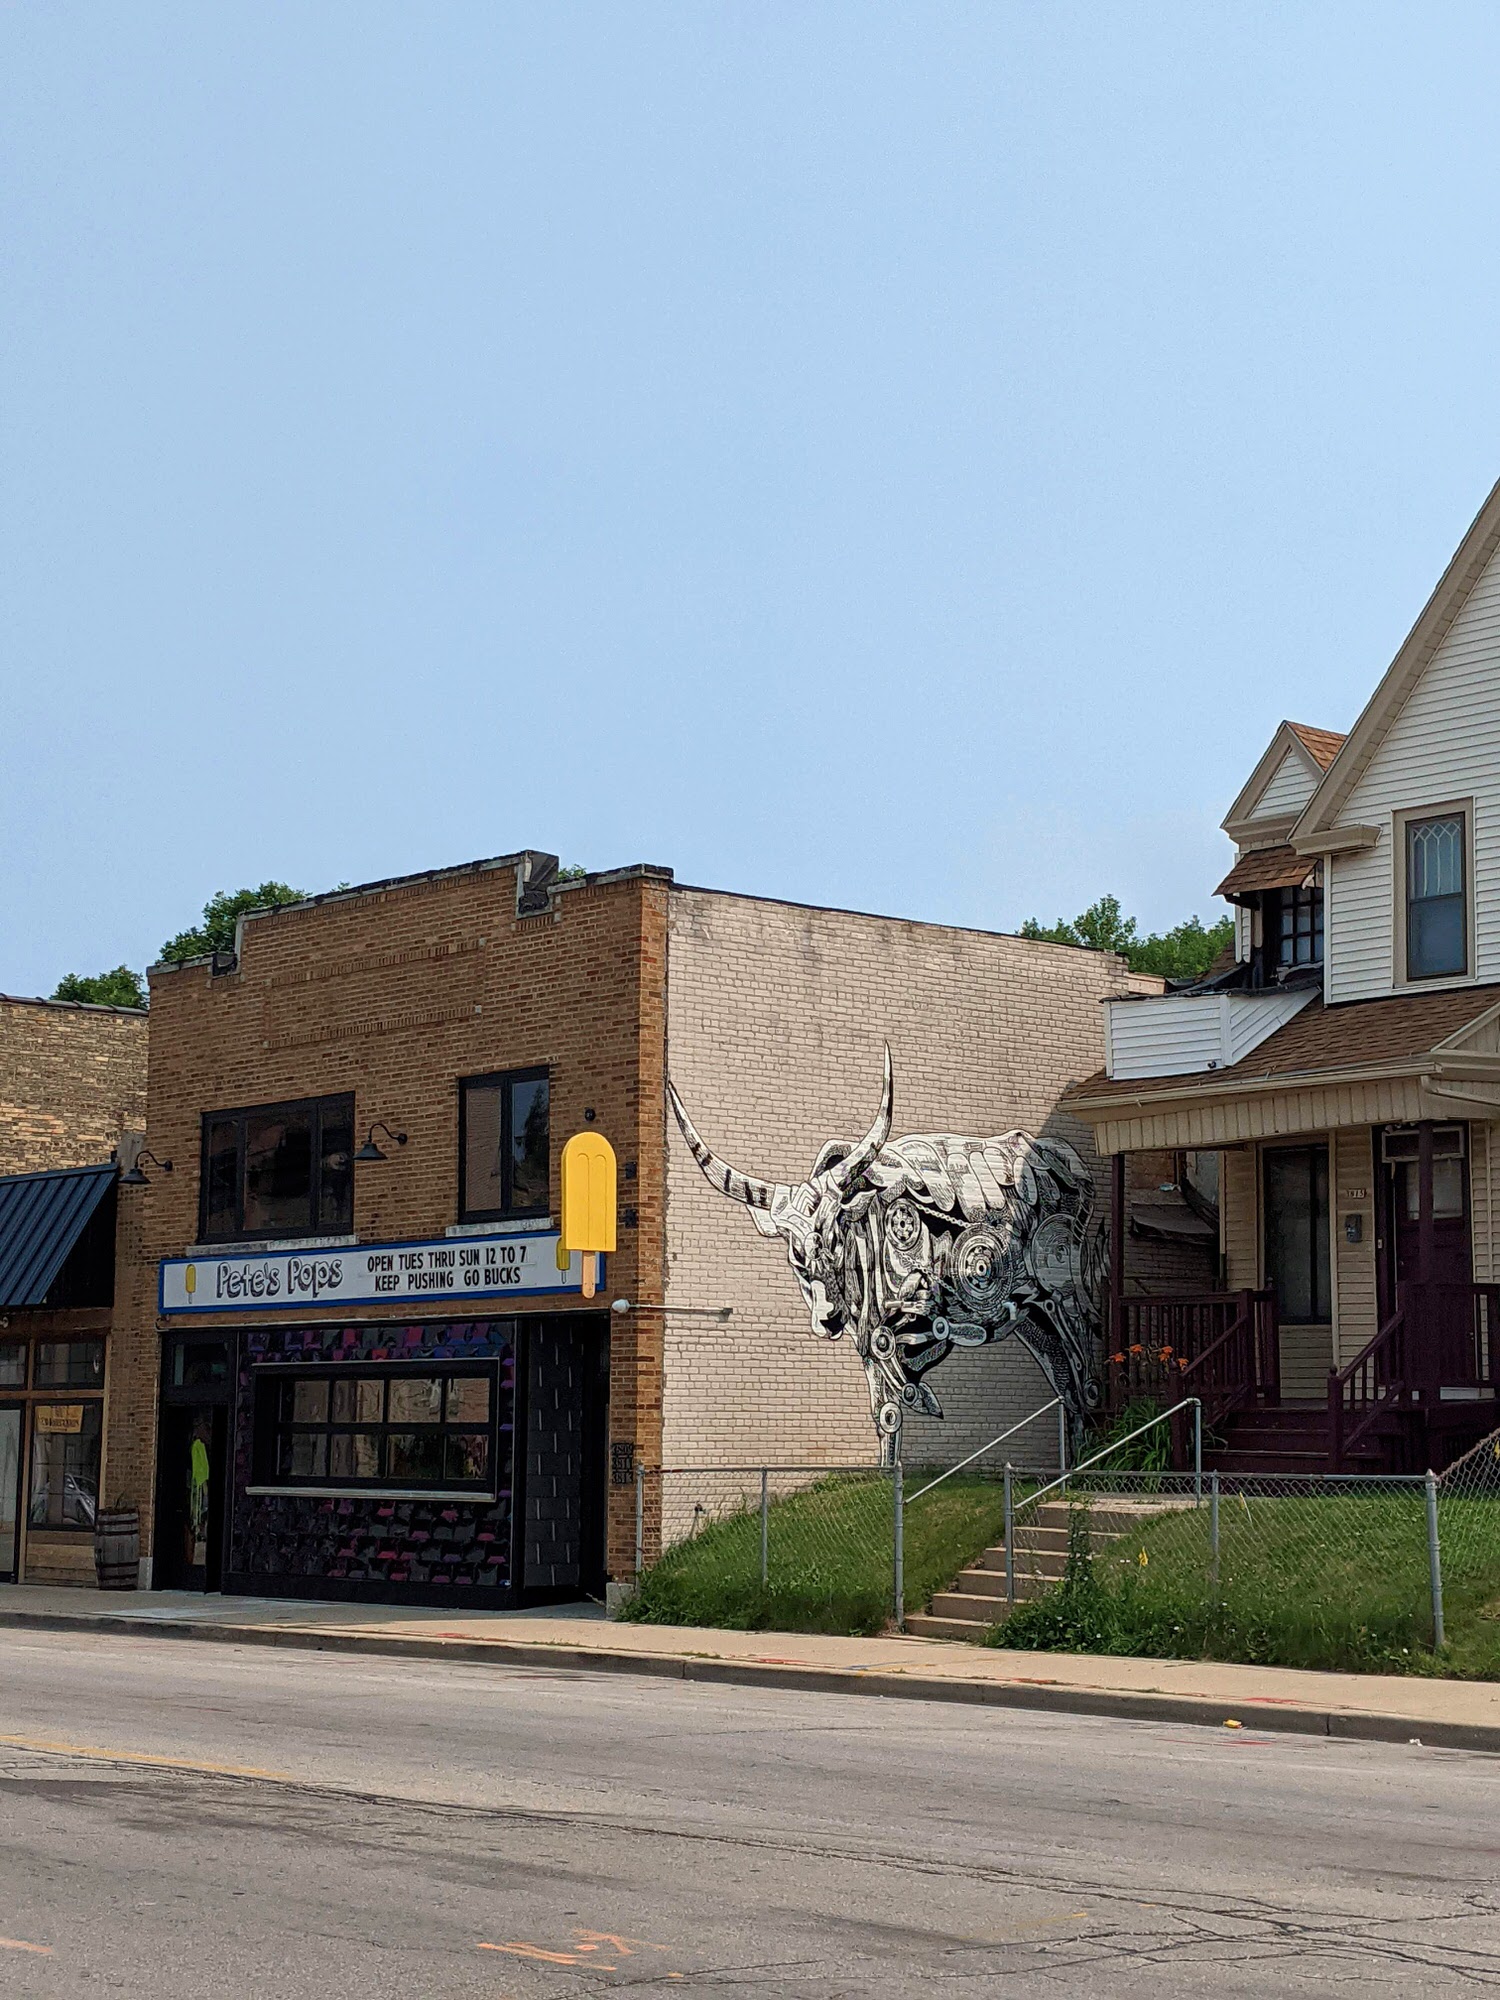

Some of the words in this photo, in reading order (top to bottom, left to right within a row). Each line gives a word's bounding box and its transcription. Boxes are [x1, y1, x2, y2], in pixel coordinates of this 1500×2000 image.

[367, 1254, 393, 1273] OPEN
[398, 1253, 424, 1271] TUES
[428, 1250, 455, 1270] THRU
[458, 1248, 480, 1267] SUN
[485, 1247, 496, 1265] 12
[500, 1246, 516, 1264] TO
[519, 1245, 527, 1263] 7
[216, 1261, 281, 1299] Pete's
[287, 1256, 344, 1299] Pops
[374, 1273, 400, 1292] KEEP
[407, 1271, 454, 1290] PUSHING
[463, 1269, 480, 1286] GO
[484, 1266, 521, 1285] BUCKS
